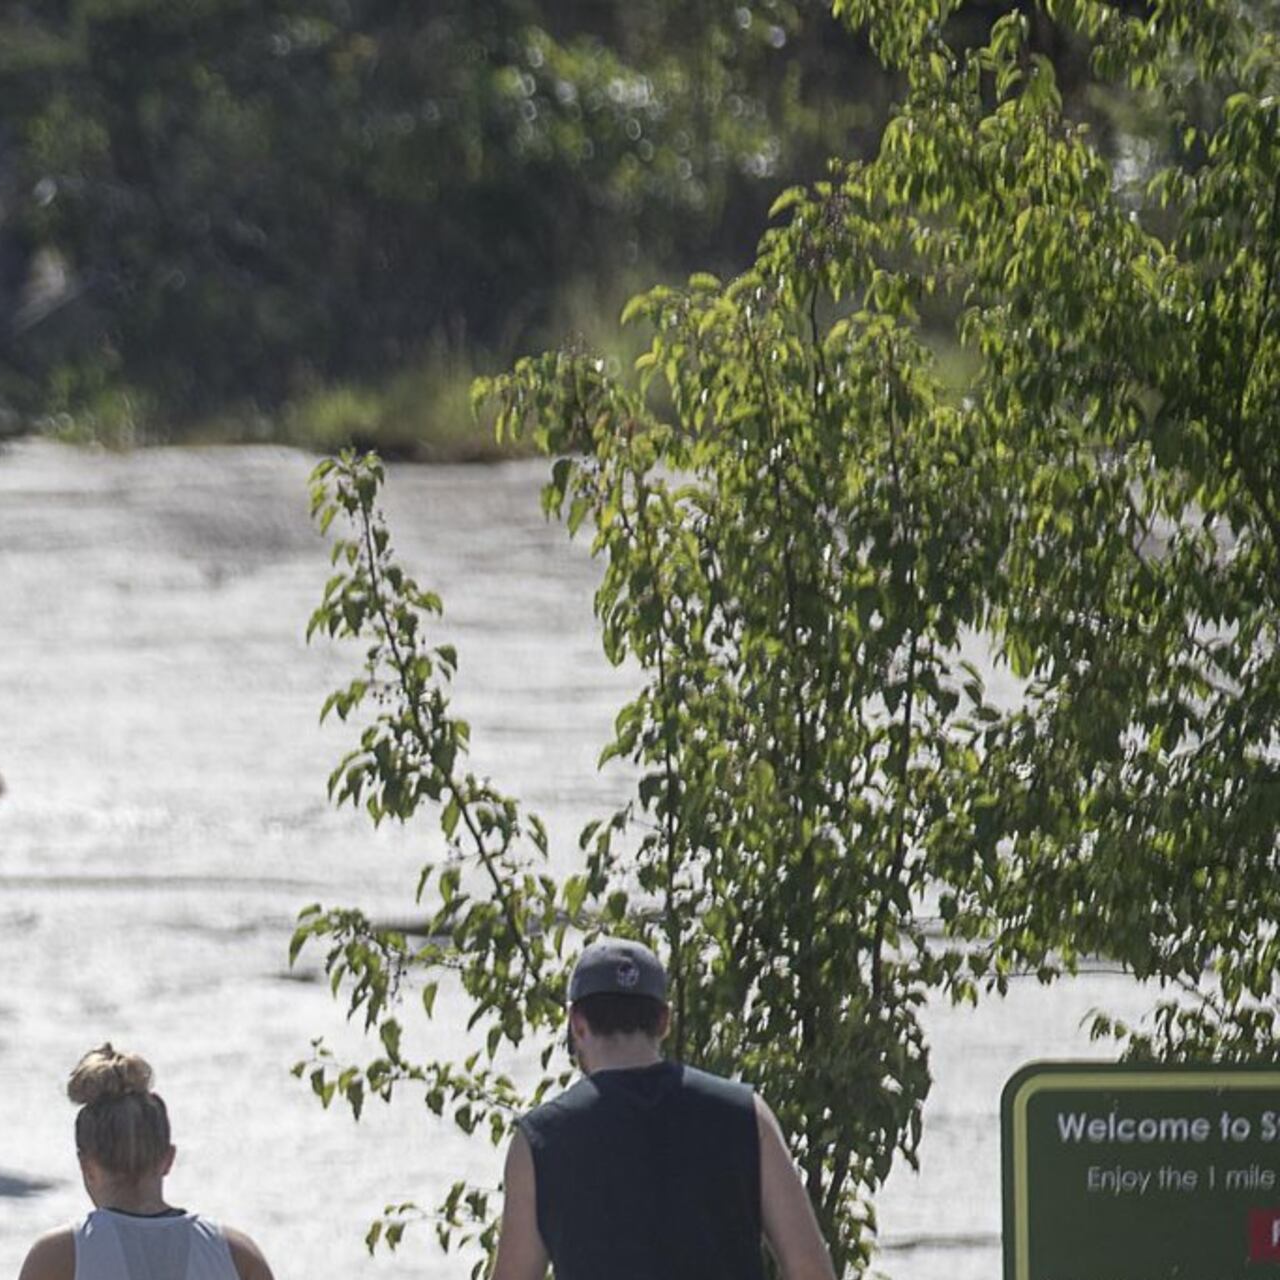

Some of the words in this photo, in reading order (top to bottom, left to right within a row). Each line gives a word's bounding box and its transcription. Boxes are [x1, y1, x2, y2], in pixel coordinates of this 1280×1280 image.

[1057, 1112, 1210, 1142] Welcome
[1220, 1110, 1251, 1141] to
[1261, 1110, 1280, 1141] S
[1087, 1166, 1151, 1195] Enjoy
[1158, 1166, 1198, 1188] the
[1225, 1163, 1276, 1190] mile
